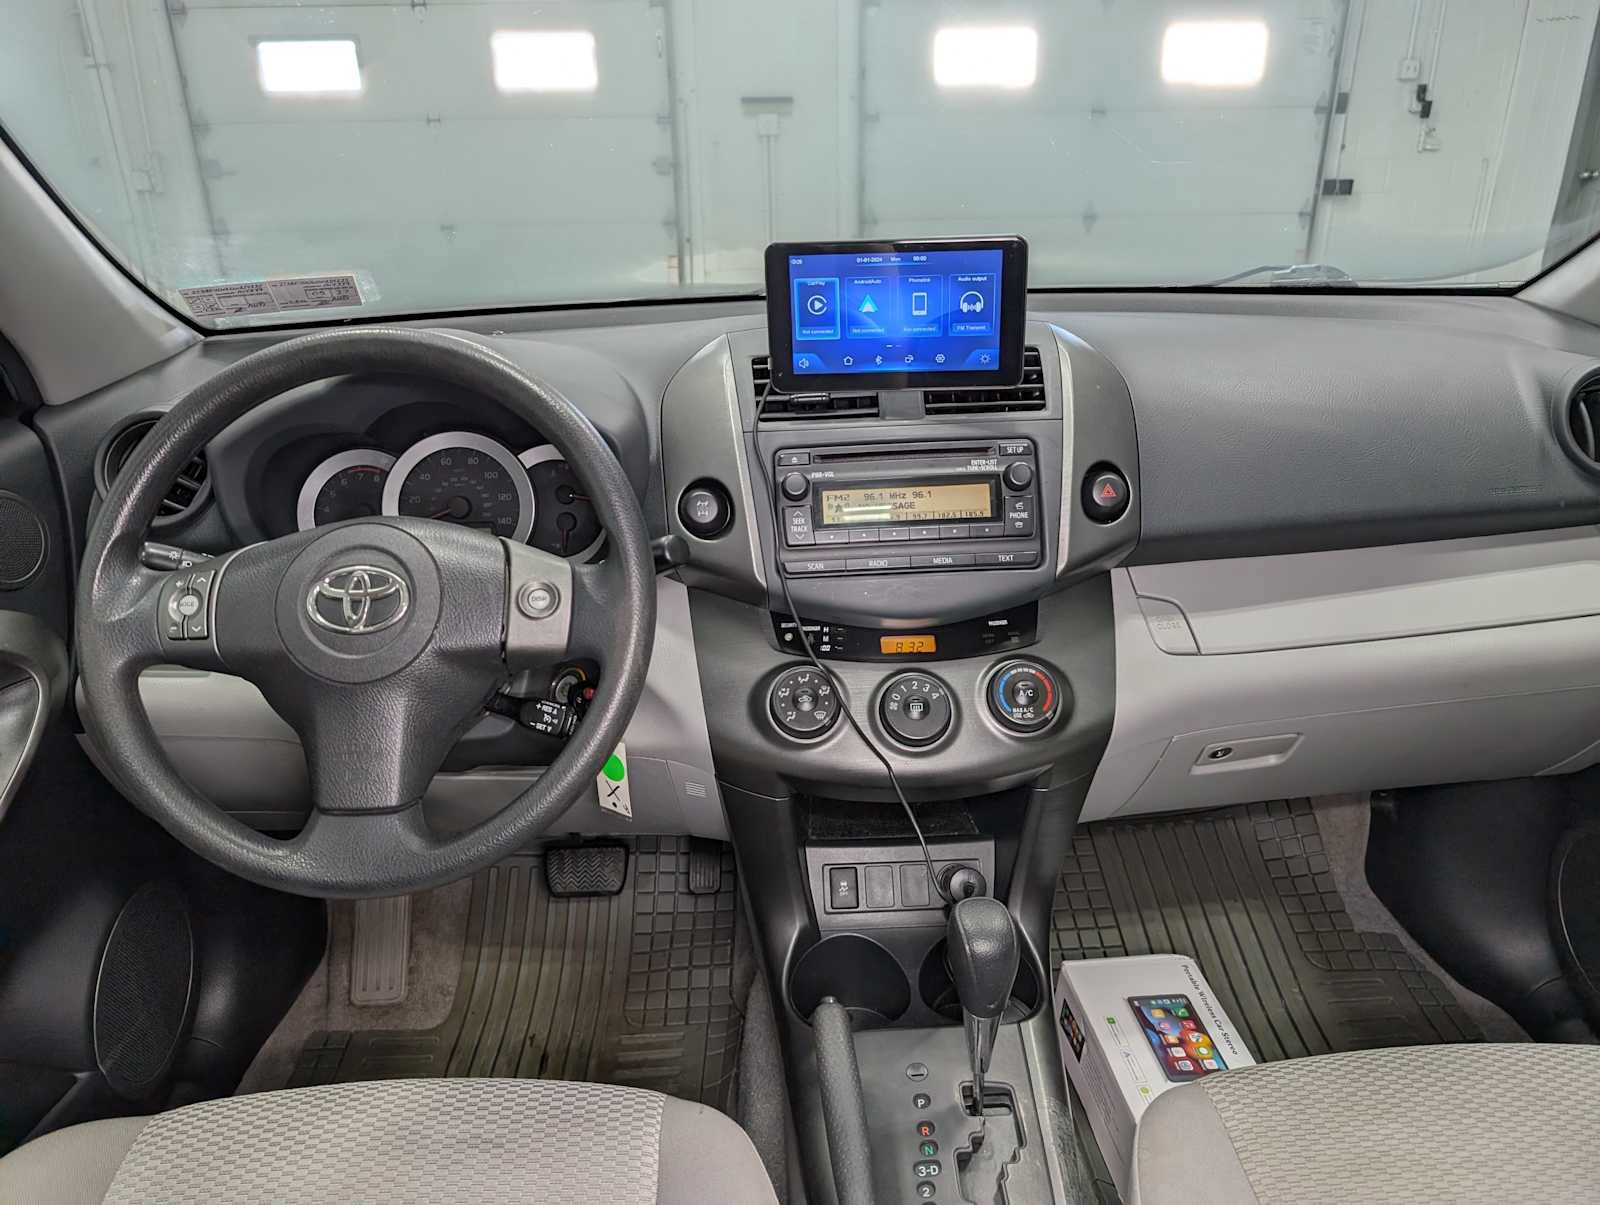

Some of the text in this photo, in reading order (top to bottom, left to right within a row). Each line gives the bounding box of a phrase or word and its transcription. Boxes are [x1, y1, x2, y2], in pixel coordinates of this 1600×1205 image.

[1006, 446, 1016, 454] SET
[889, 492, 907, 500] MHz
[912, 490, 932, 498] 96.1
[933, 557, 953, 565] MEDIA
[998, 554, 1014, 562] TEXT
[912, 681, 918, 689] 2
[923, 683, 930, 692] 3
[1018, 689, 1033, 697] A/C
[1182, 964, 1238, 1056] Portable Wireless Car Stereo
[918, 1099, 925, 1108] P
[922, 1126, 929, 1136] R
[925, 1145, 934, 1156] N
[918, 1166, 939, 1176] 3-D
[922, 1187, 930, 1197] 2
